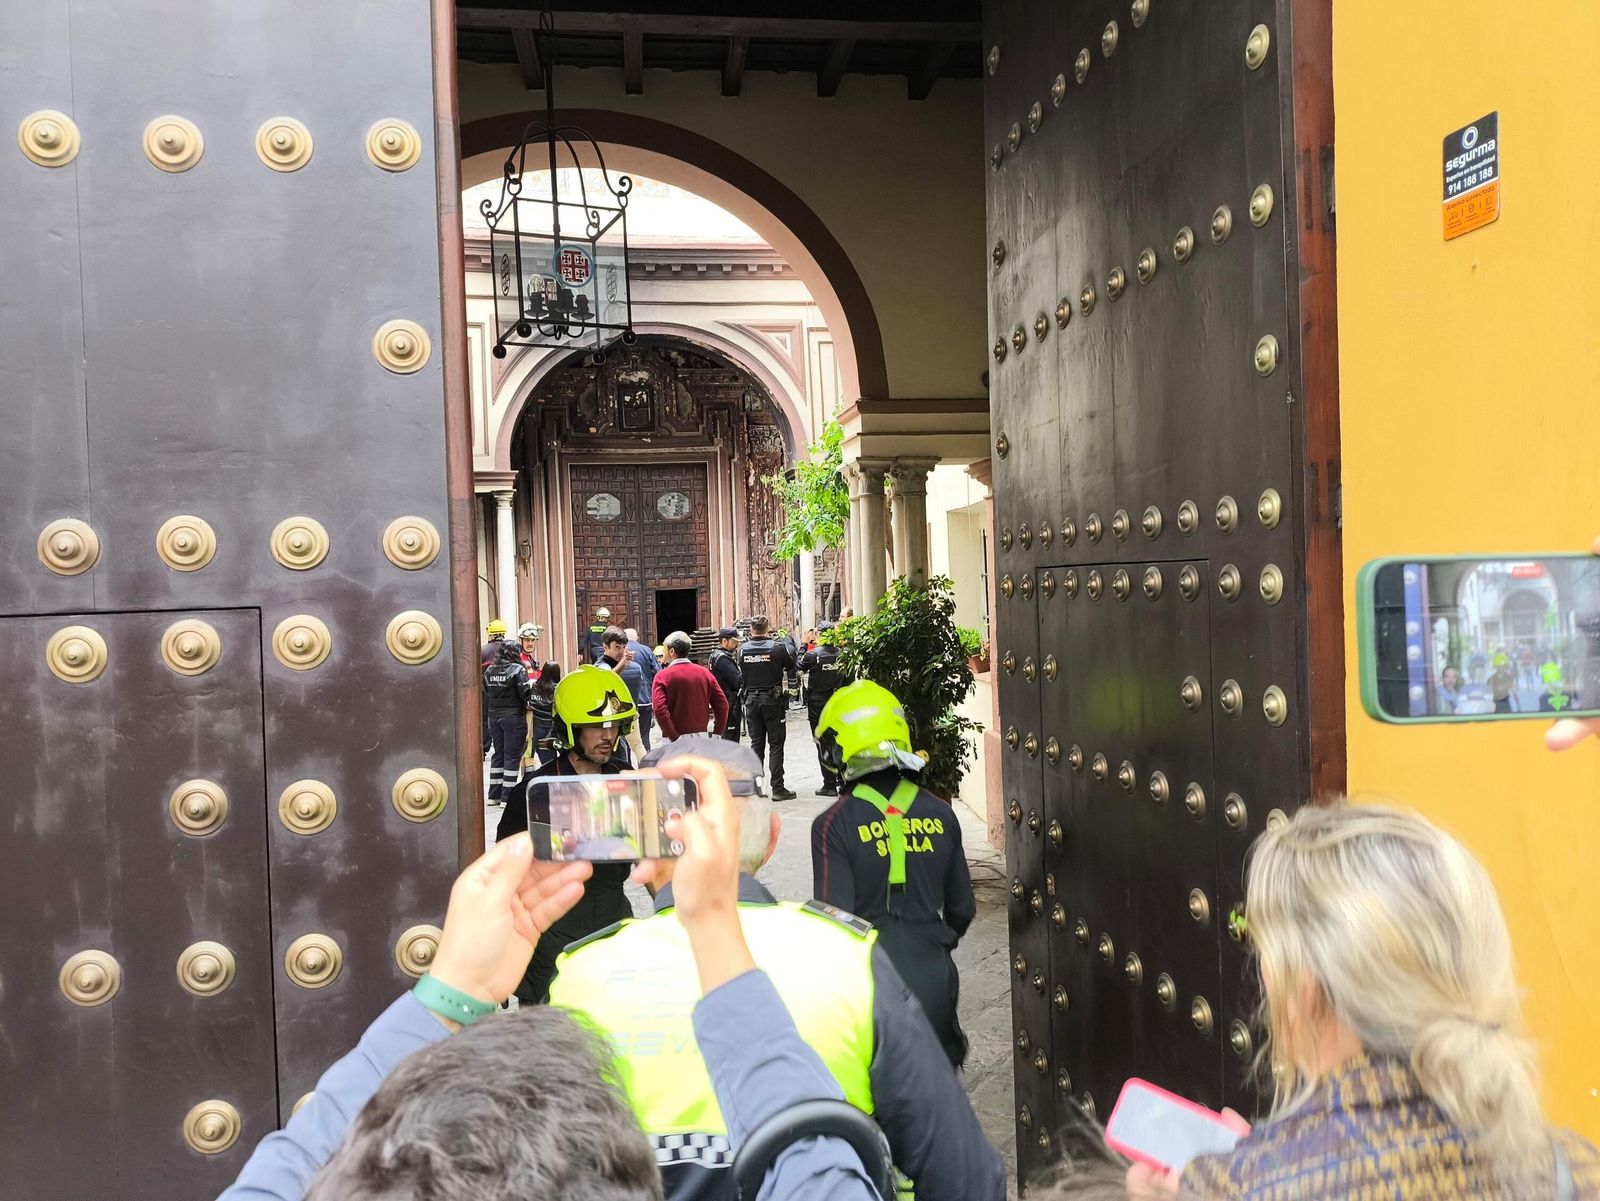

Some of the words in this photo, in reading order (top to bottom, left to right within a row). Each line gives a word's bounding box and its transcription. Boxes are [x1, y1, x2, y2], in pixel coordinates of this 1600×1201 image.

[1445, 138, 1496, 173] segurma
[1448, 180, 1462, 195] 914
[1463, 174, 1477, 189] 188
[1479, 166, 1493, 182] 188
[857, 818, 944, 843] BOMEROS
